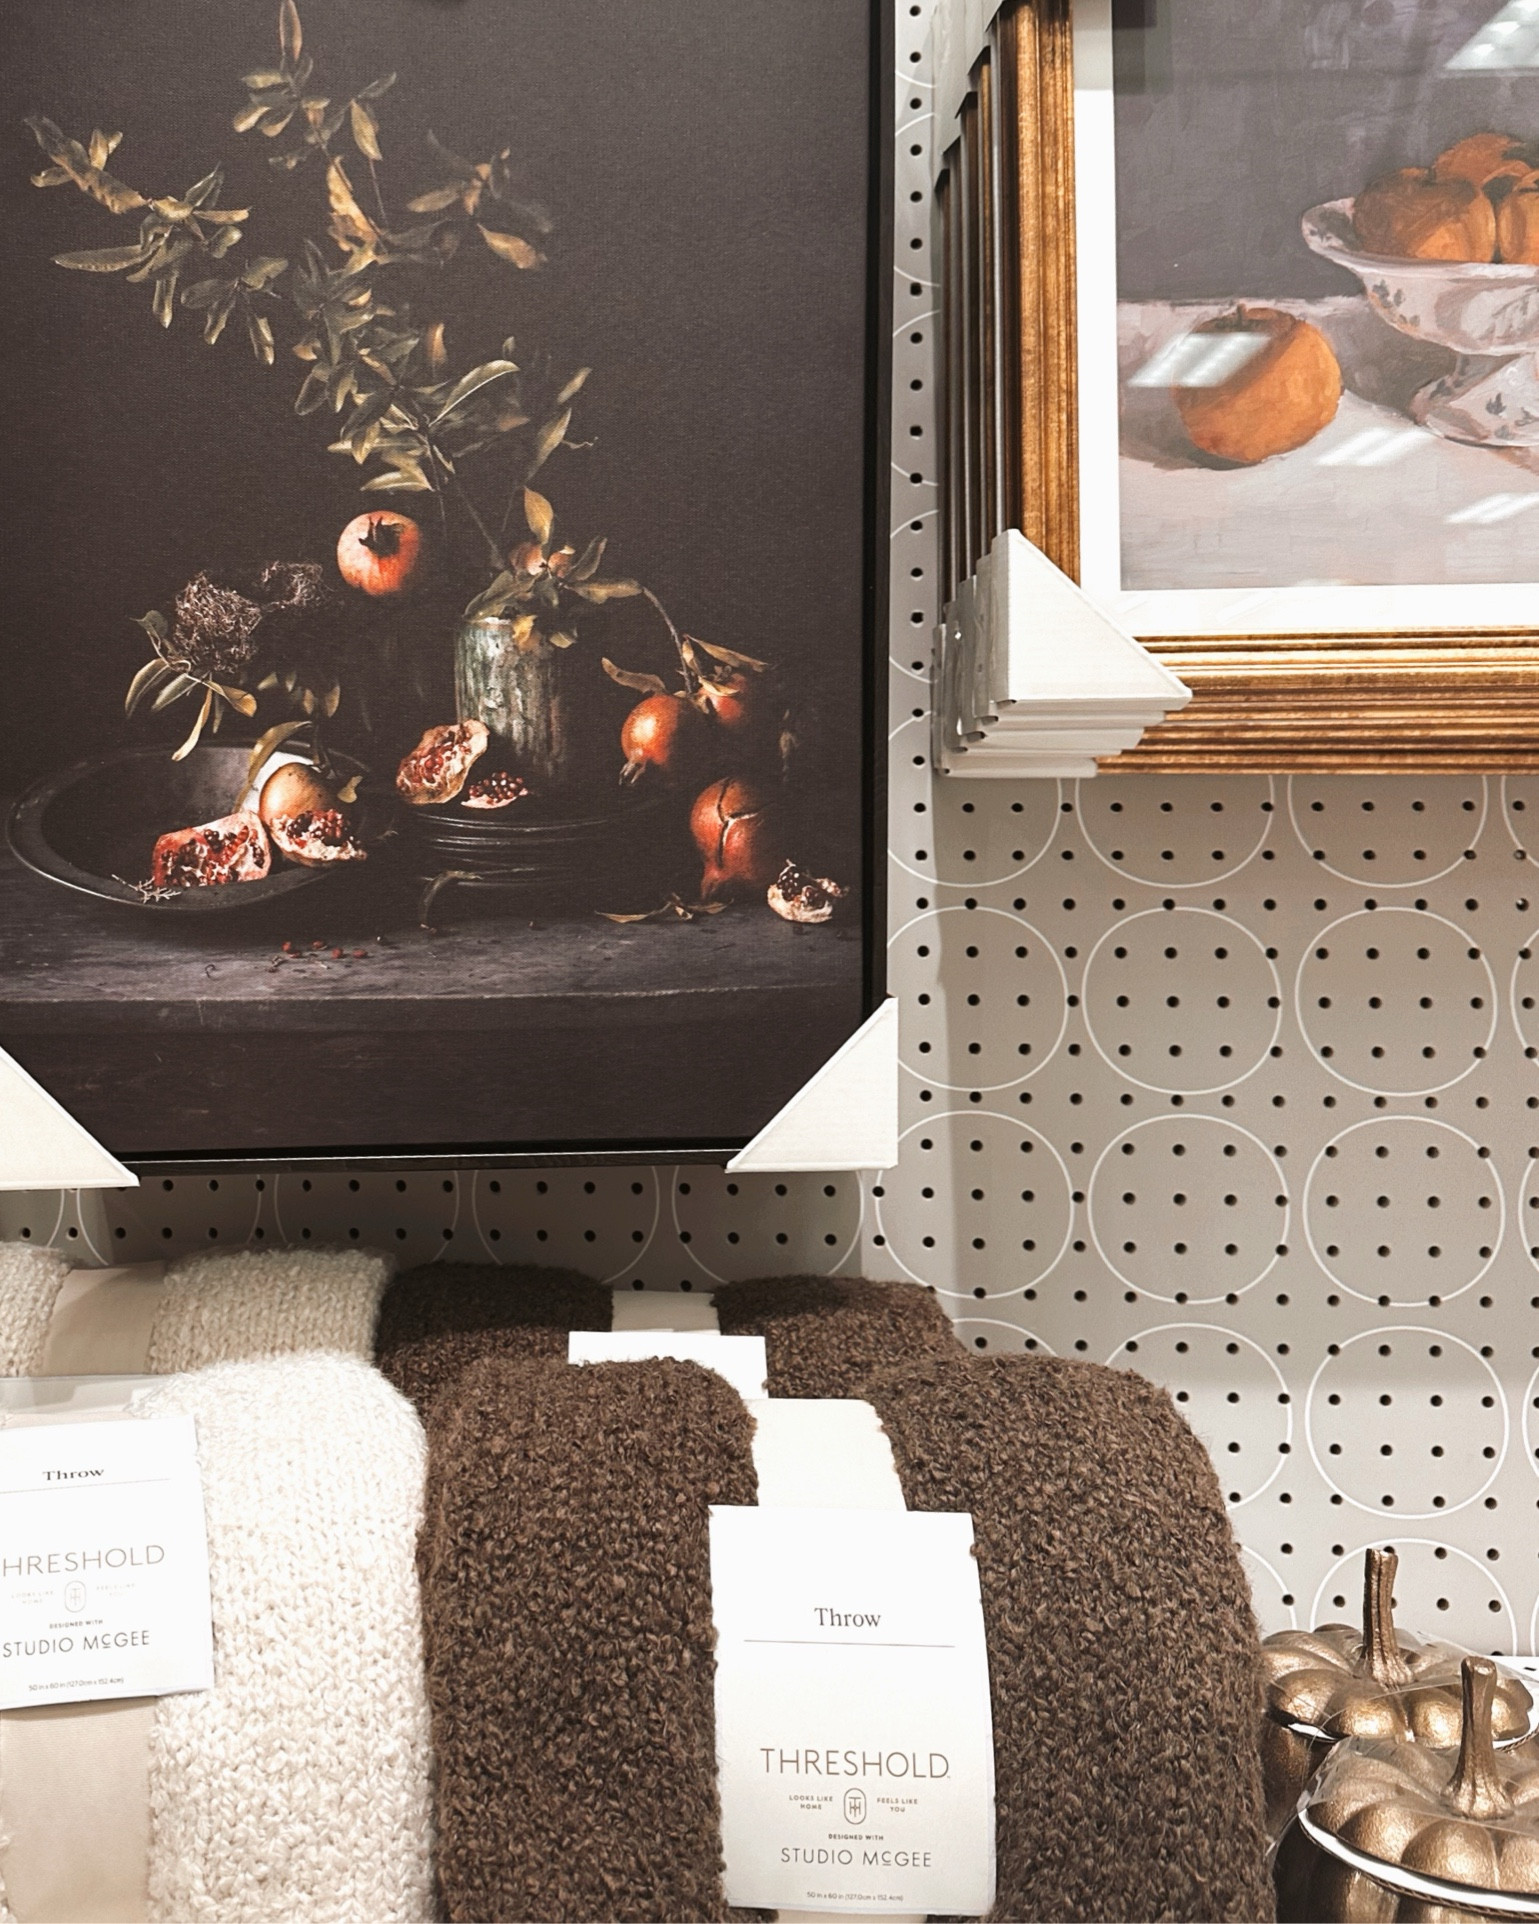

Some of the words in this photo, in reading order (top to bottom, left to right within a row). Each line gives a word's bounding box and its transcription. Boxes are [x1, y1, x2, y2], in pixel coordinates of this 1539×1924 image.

[42, 1467, 104, 1481] Throw
[2, 1545, 165, 1577] HRESHOLD
[49, 1620, 83, 1629] DESIGNED
[814, 1606, 882, 1628] Throw
[2, 1637, 74, 1658] STUDIO
[759, 1747, 950, 1779] THRESHOLD
[788, 1794, 814, 1802] LOOKS
[876, 1797, 899, 1805] FEELS
[828, 1833, 863, 1841] DESIGNED
[781, 1847, 853, 1866] STUDIO
